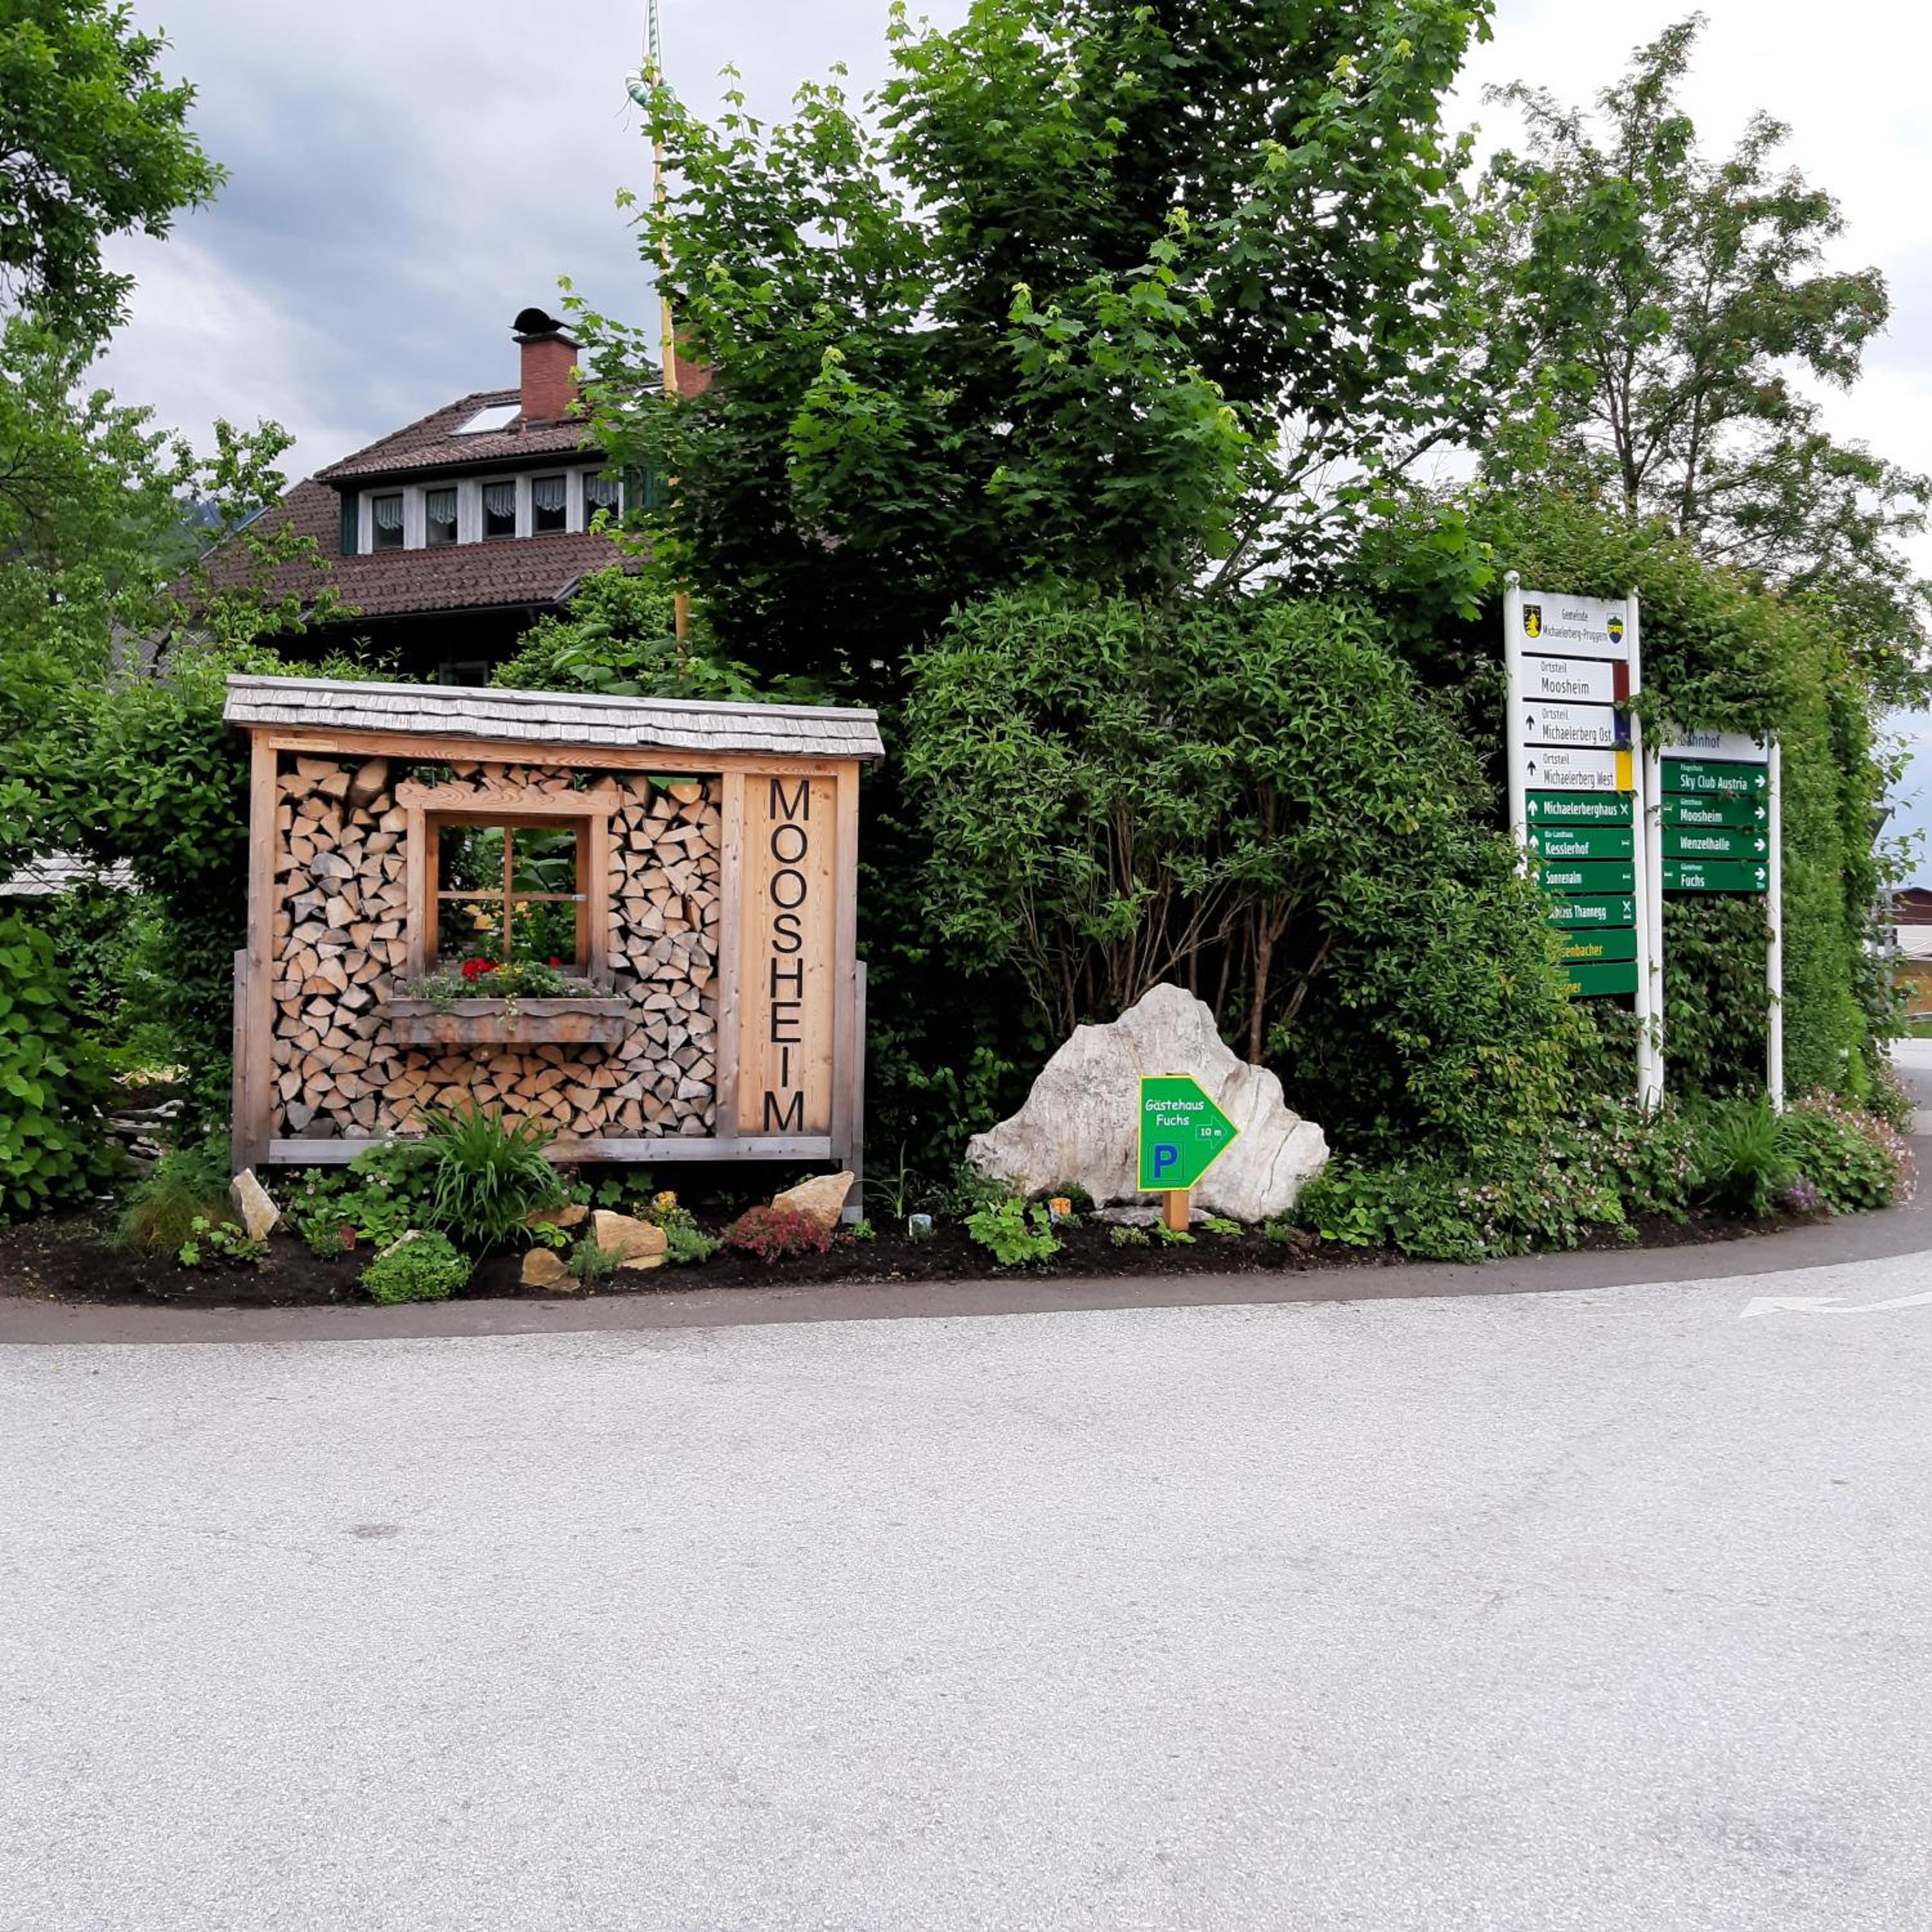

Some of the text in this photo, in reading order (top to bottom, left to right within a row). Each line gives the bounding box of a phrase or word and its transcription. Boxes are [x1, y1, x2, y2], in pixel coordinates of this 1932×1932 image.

[1562, 609, 1588, 620] Gemeinde
[1540, 661, 1567, 673] Ortsteil
[1541, 677, 1589, 694] Moosheim
[1542, 708, 1569, 719] Ortsteil
[1542, 724, 1611, 744] Michaelerberg Ost
[1543, 753, 1569, 764] Ortsteil
[1544, 769, 1613, 788] Michaelerberg West
[1680, 774, 1747, 790] Sky Club Austria
[1544, 801, 1617, 818] Michaelerberghaus
[1680, 809, 1722, 822] Moosheim
[1545, 842, 1589, 855] Kesslerhof
[1680, 837, 1730, 850] Wenzelhalle
[1546, 871, 1582, 884] Sonnenalm
[1681, 874, 1704, 887] Fuchs
[1574, 905, 1607, 920] Thannegg
[763, 779, 810, 1132] MOOSHEIM
[1146, 1099, 1204, 1111] Gästehaus
[1156, 1114, 1189, 1126] Fuchs
[1201, 1128, 1211, 1137] 10
[1153, 1144, 1179, 1178] P
